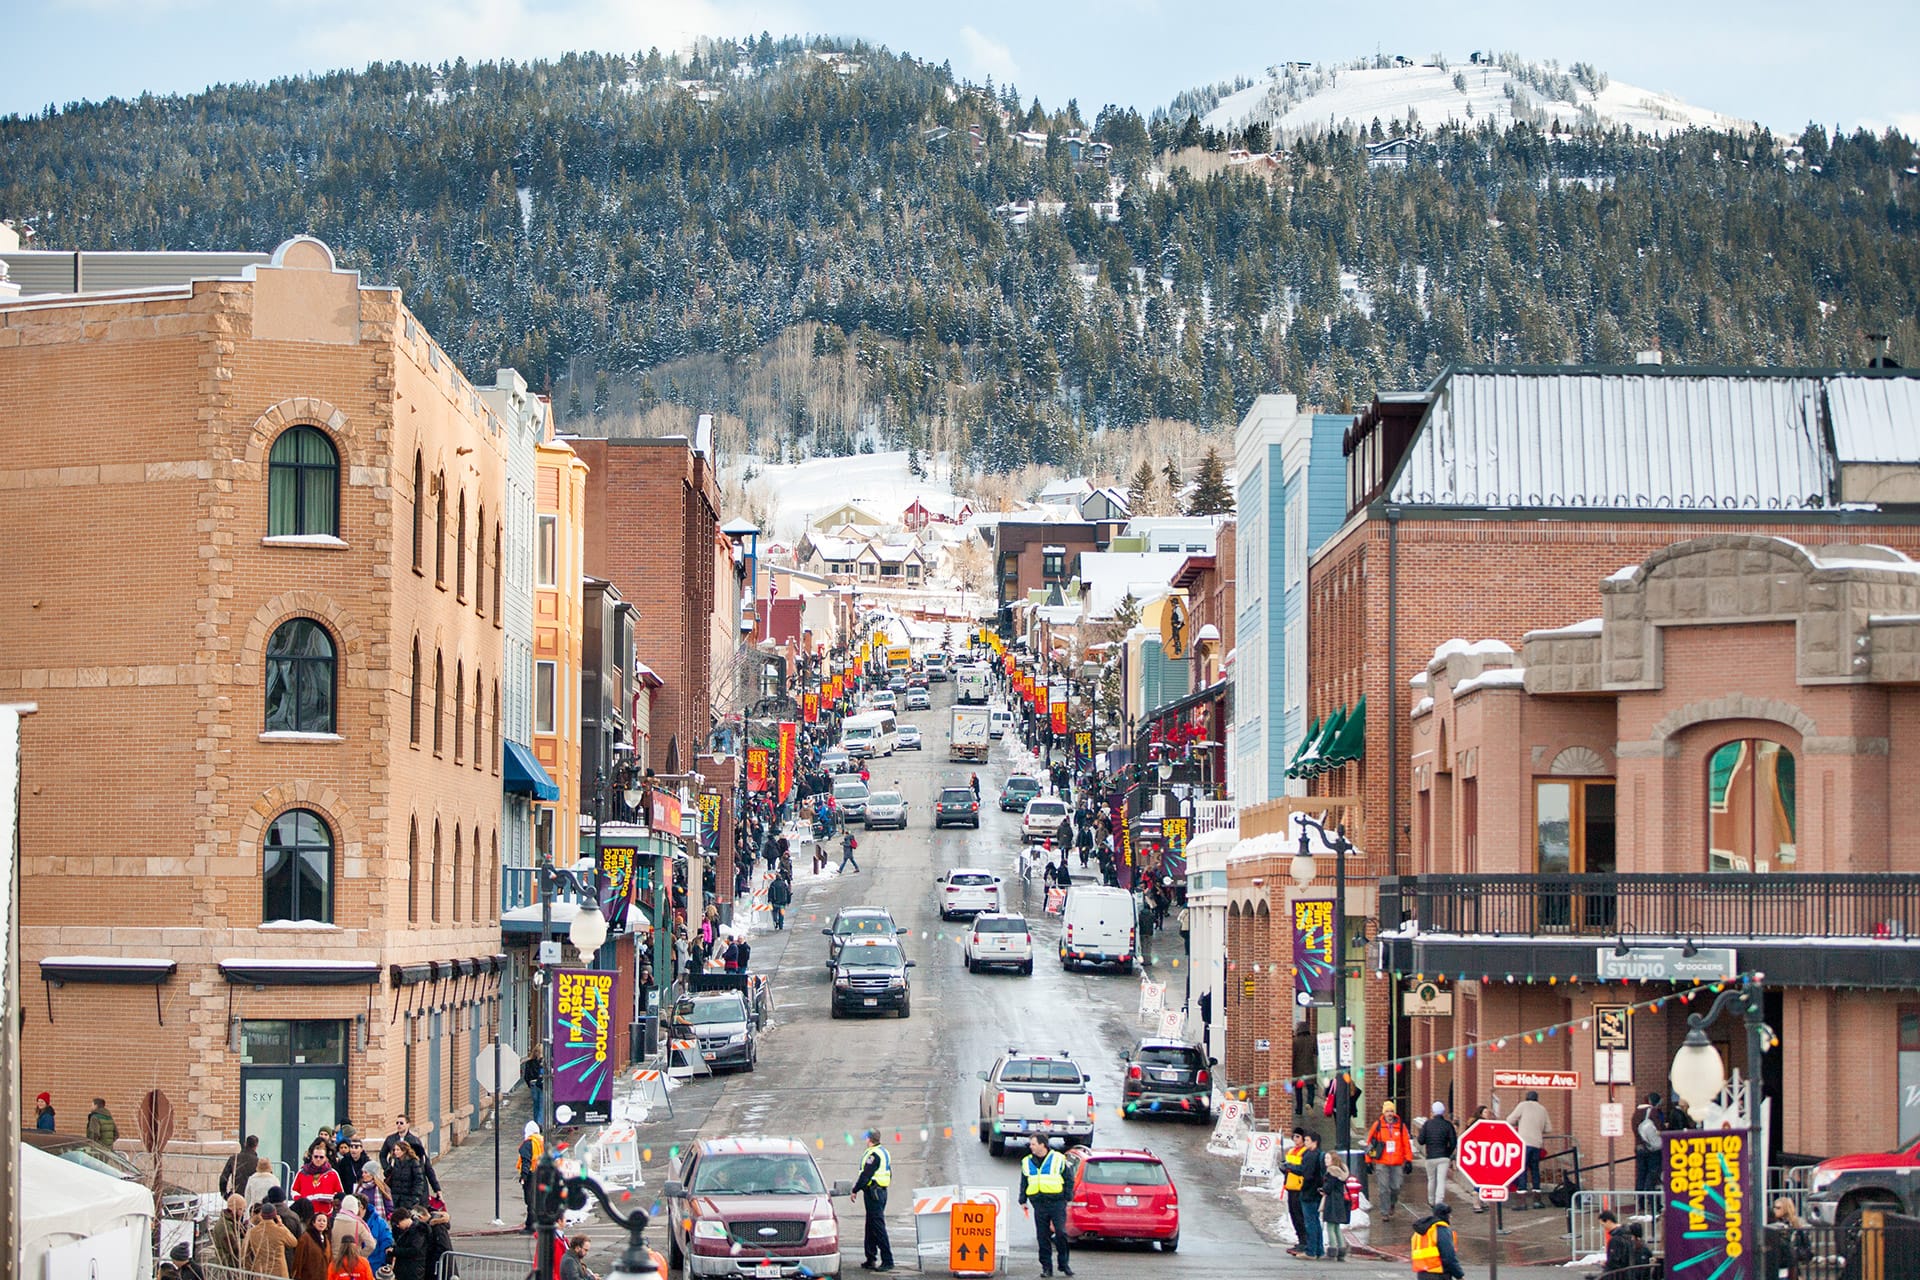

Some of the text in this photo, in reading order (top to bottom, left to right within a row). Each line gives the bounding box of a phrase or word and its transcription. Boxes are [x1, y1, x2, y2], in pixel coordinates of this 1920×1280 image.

[960, 675, 982, 683] FedEx
[620, 848, 634, 897] Sundance
[1296, 902, 1304, 930] 2016
[1314, 902, 1322, 927] Film
[1324, 902, 1333, 963] Sundance
[1606, 962, 1724, 977] STUDIO DOCKERS
[558, 973, 572, 1014] 2016
[570, 974, 586, 1042] Festival
[584, 974, 598, 1011] Film
[595, 975, 612, 1062] Sundance
[252, 1093, 273, 1102] SKY
[1517, 1073, 1551, 1085] Heber
[1551, 1074, 1576, 1086] Ave.
[1462, 1140, 1520, 1168] STOP
[1670, 1138, 1688, 1194] 2016
[1705, 1136, 1723, 1187] Film
[1688, 1137, 1708, 1230] Festival
[1723, 1135, 1744, 1258] Sundance
[955, 1228, 992, 1237] TURNS
[964, 1213, 984, 1224] NO
